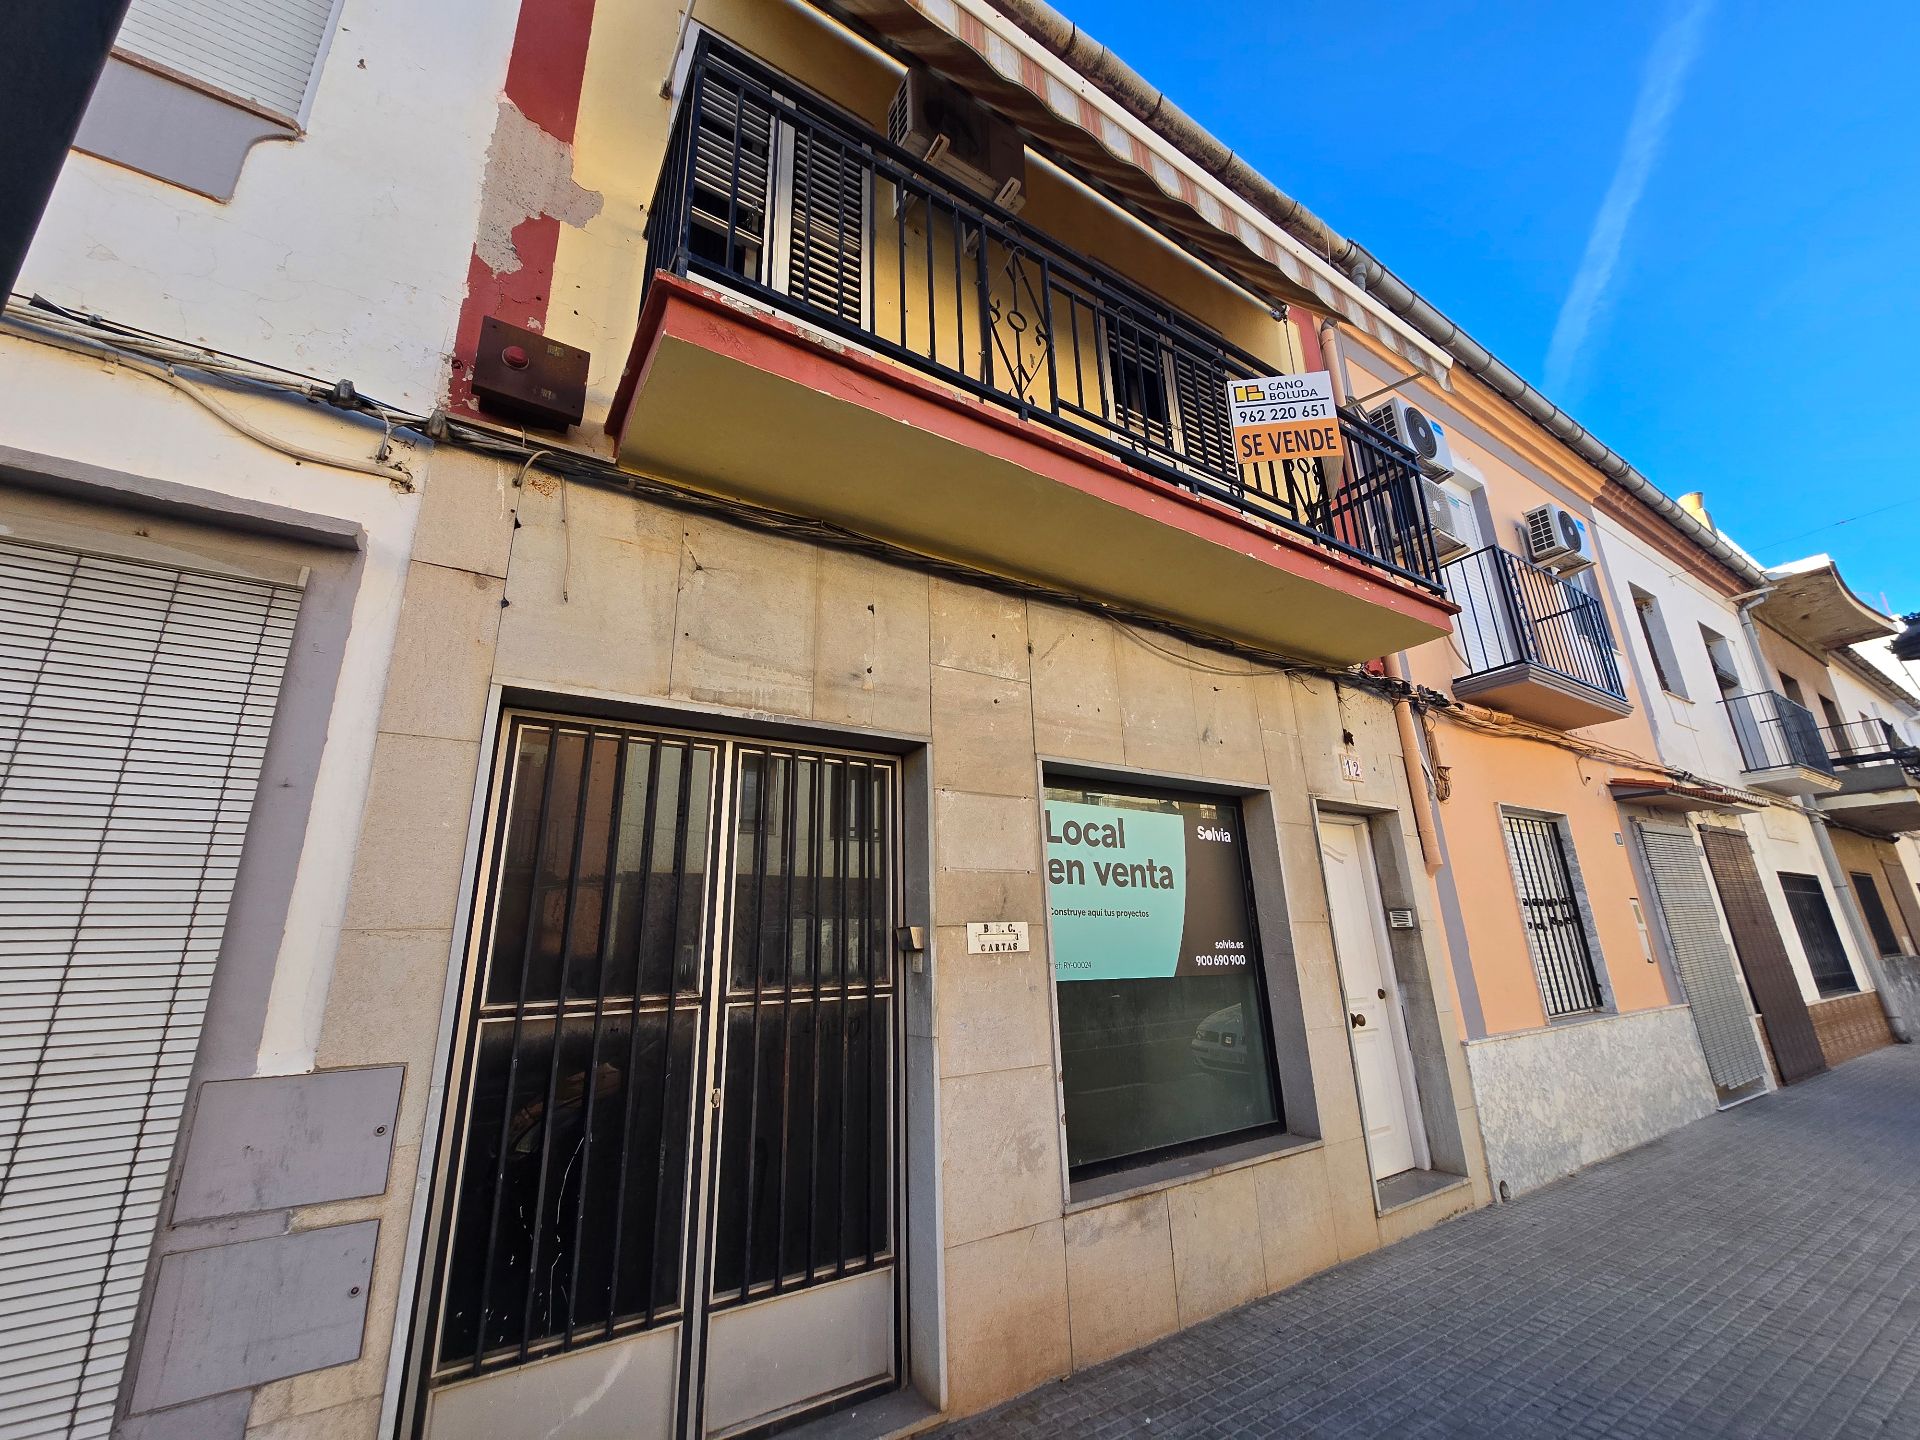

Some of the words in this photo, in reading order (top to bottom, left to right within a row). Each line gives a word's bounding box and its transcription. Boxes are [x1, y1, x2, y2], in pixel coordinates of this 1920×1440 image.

[1268, 379, 1304, 391] CANO
[1269, 388, 1319, 401] BOLUDA
[1239, 409, 1266, 423] 962
[1270, 406, 1297, 421] 220
[1302, 403, 1327, 417] 651
[1241, 433, 1265, 458] SE
[1267, 427, 1337, 455] VENDE
[1345, 759, 1360, 777] 12
[1044, 809, 1126, 849] Local
[1196, 825, 1232, 843] Solvia
[1047, 858, 1086, 886] en
[1093, 858, 1175, 890] venta
[1104, 908, 1115, 917] tus
[1116, 909, 1150, 919] proyectos
[980, 942, 1018, 952] CARTAS
[1214, 939, 1245, 949] solvia.es
[1195, 954, 1213, 966] 900
[1213, 954, 1229, 966] 690
[1229, 954, 1246, 966] 900
